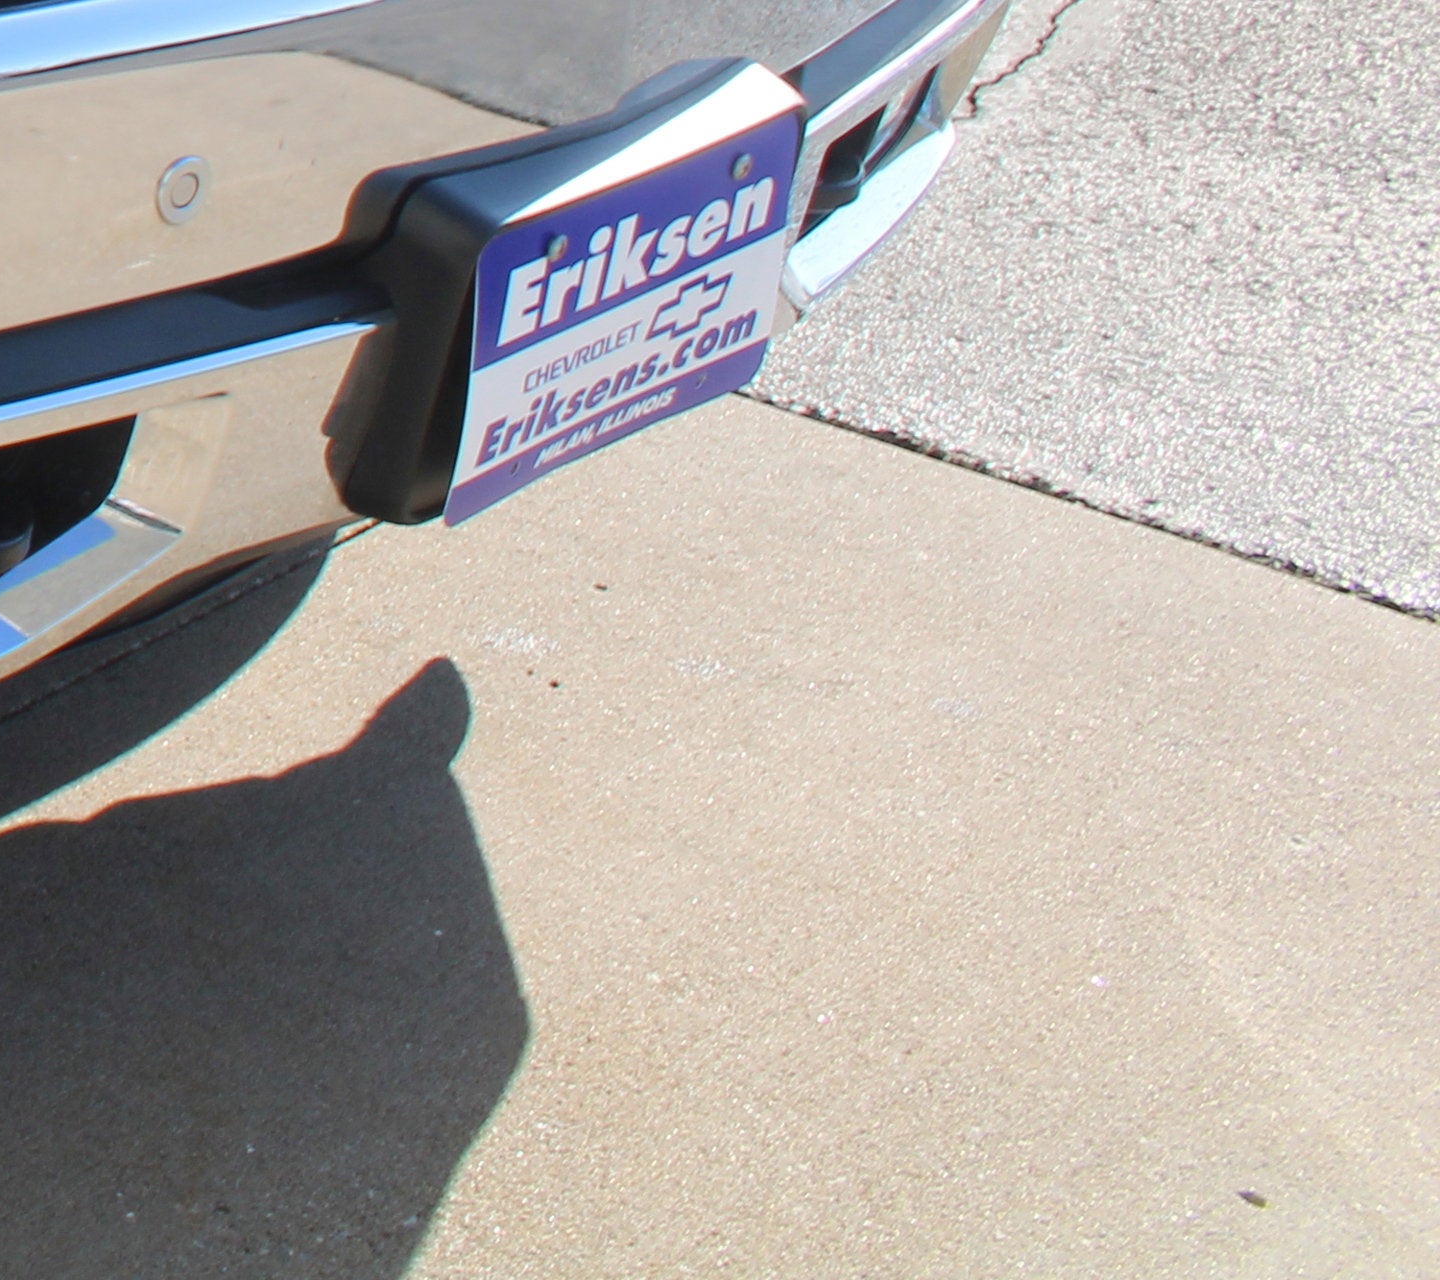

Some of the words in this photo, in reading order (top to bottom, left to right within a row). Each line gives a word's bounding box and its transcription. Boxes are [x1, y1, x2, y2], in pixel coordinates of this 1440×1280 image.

[496, 175, 774, 348] Eriksen
[474, 306, 757, 469] Eriksens.com
[522, 323, 640, 394] CHEVROLET
[594, 386, 680, 438] ILLINOIS
